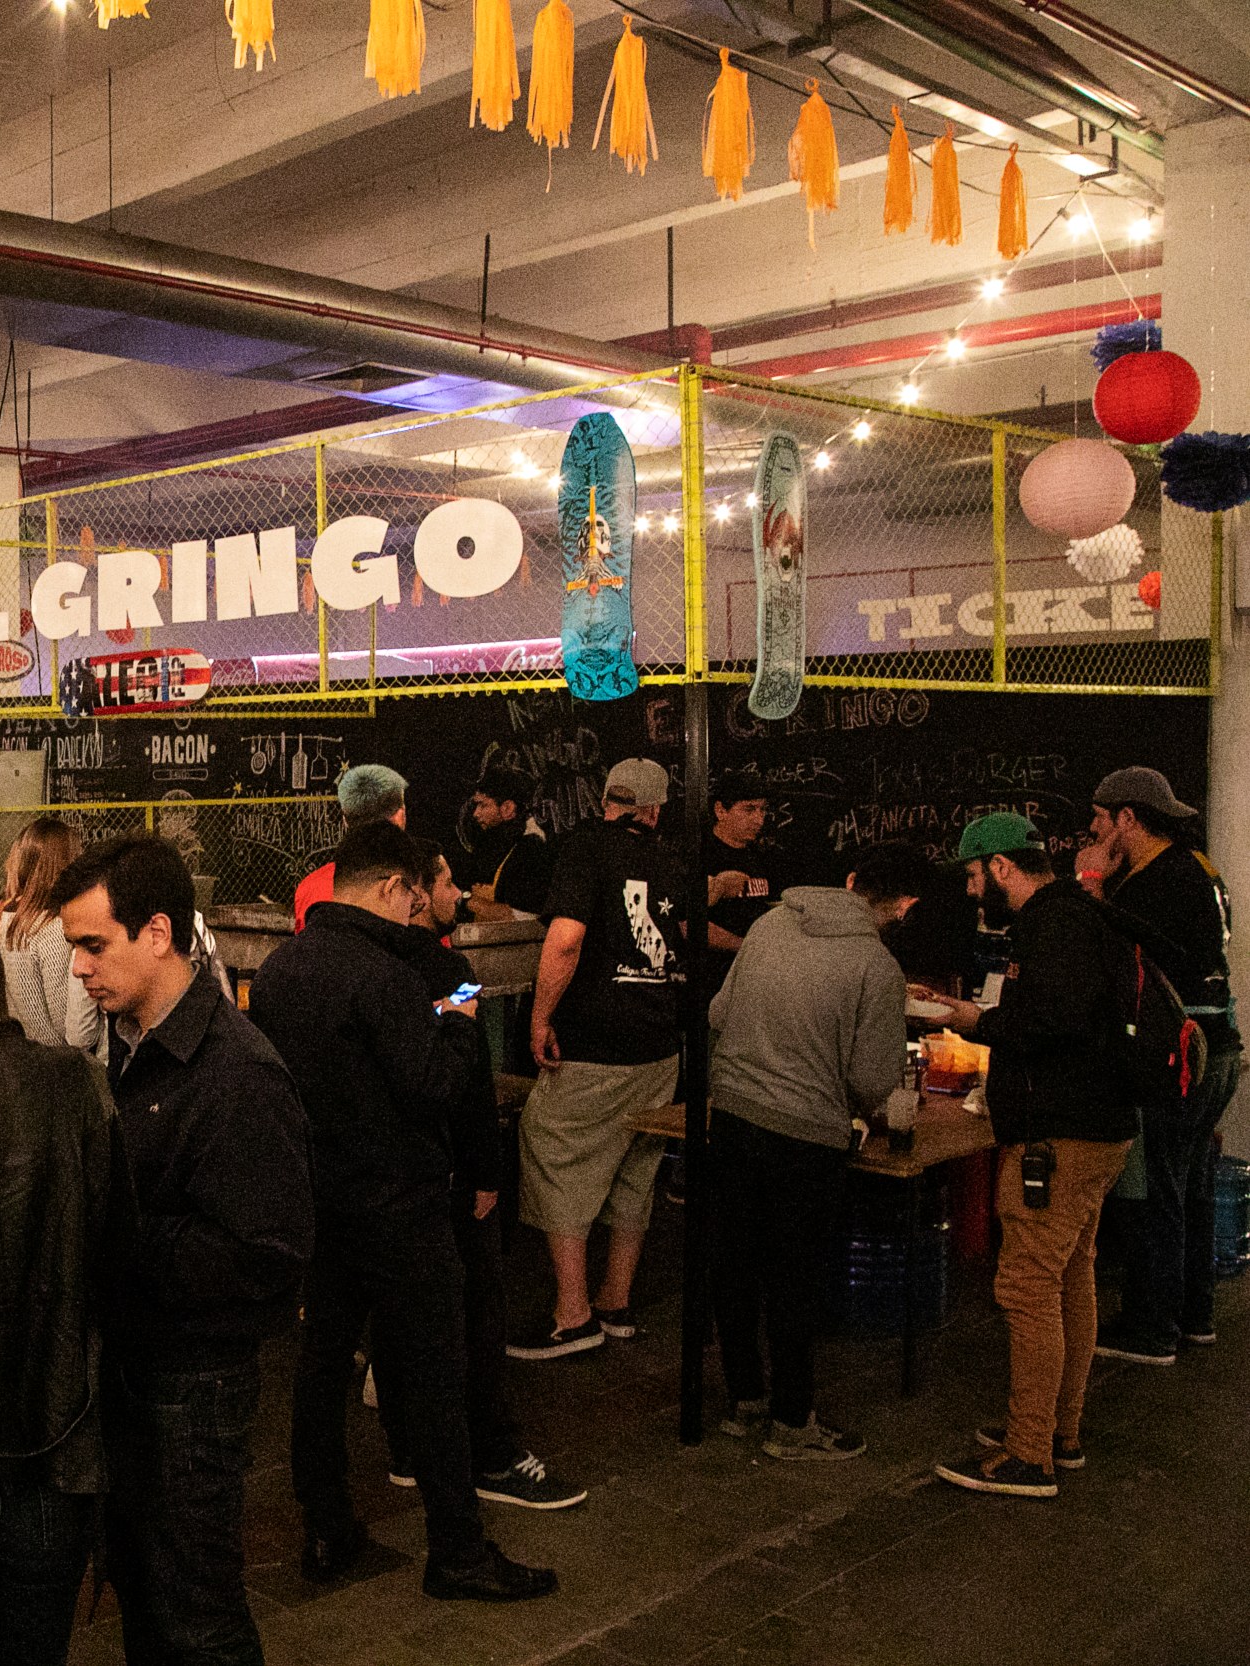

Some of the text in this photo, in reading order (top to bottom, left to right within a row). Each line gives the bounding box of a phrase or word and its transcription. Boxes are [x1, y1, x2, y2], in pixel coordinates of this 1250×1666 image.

[31, 498, 523, 640] GRINGO
[858, 583, 1154, 641] TICKE
[152, 734, 209, 764] BACON
